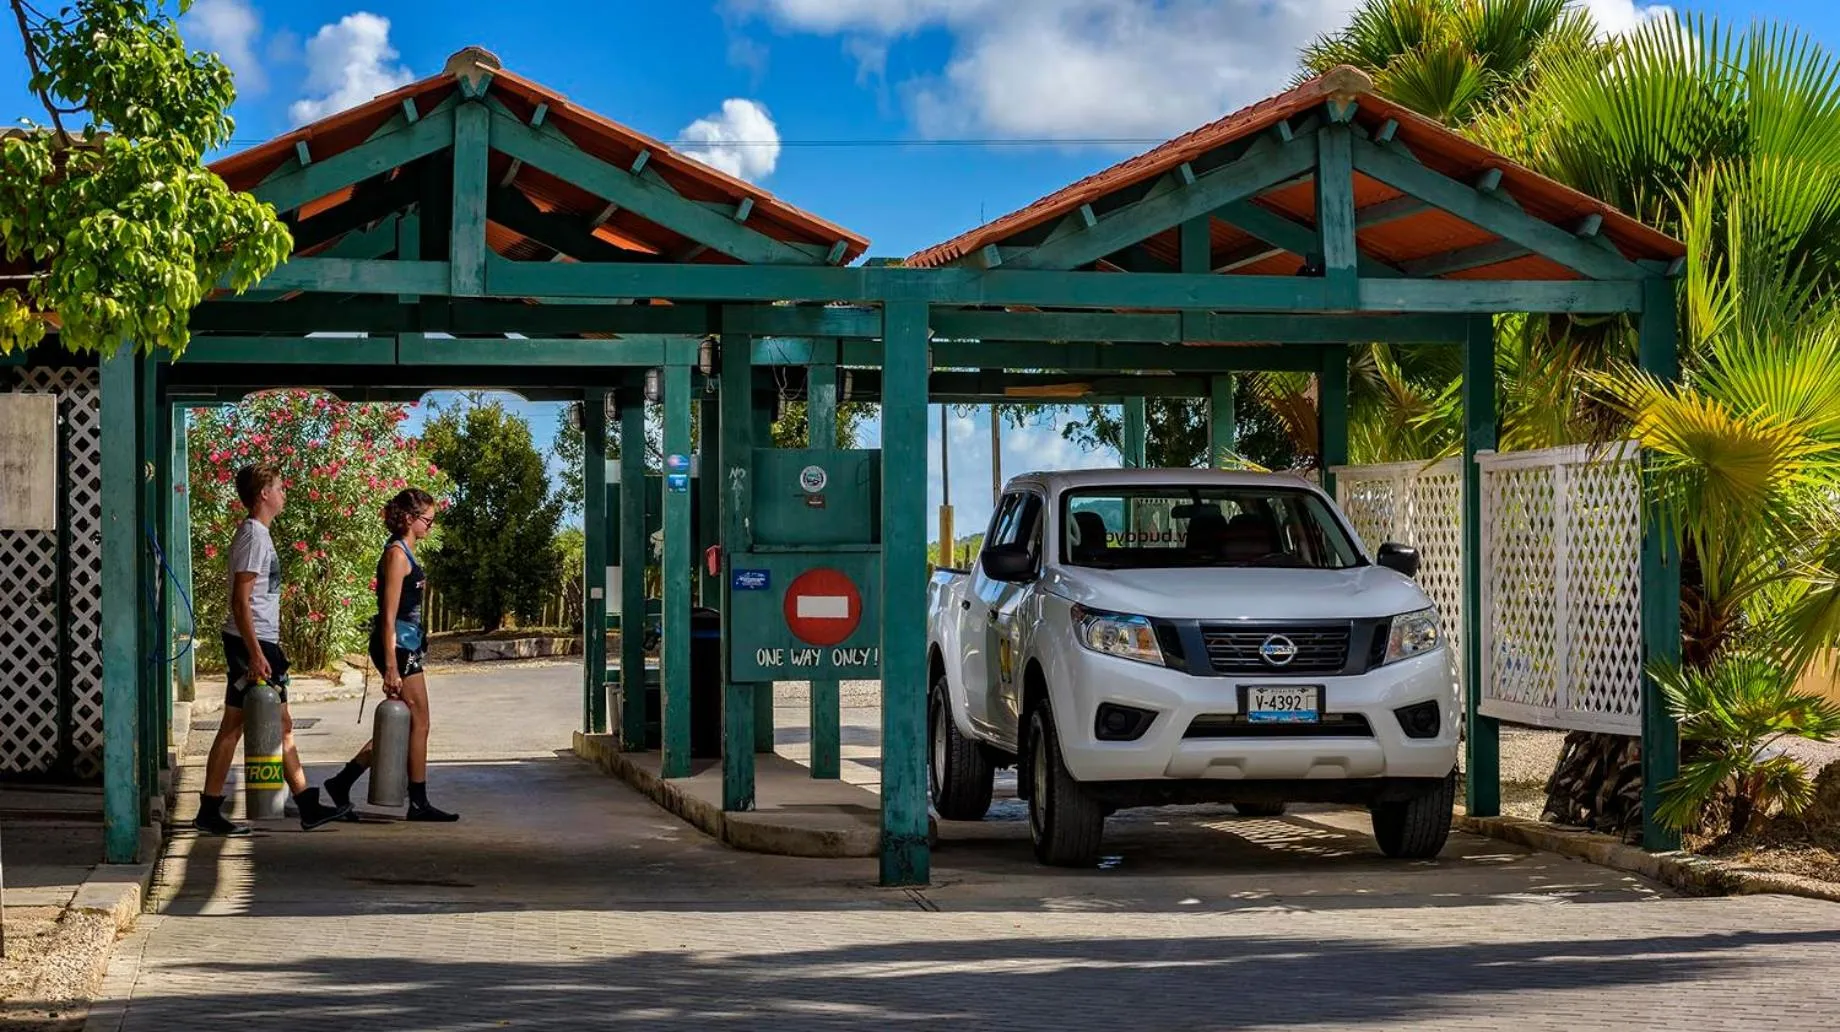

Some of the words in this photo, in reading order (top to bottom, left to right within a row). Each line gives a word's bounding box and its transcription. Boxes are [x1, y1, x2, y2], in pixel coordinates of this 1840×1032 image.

[729, 466, 746, 479] NO
[756, 648, 784, 667] ONE
[790, 648, 821, 666] WAY
[832, 647, 879, 666] ONLY!
[1256, 695, 1301, 711] V-4392
